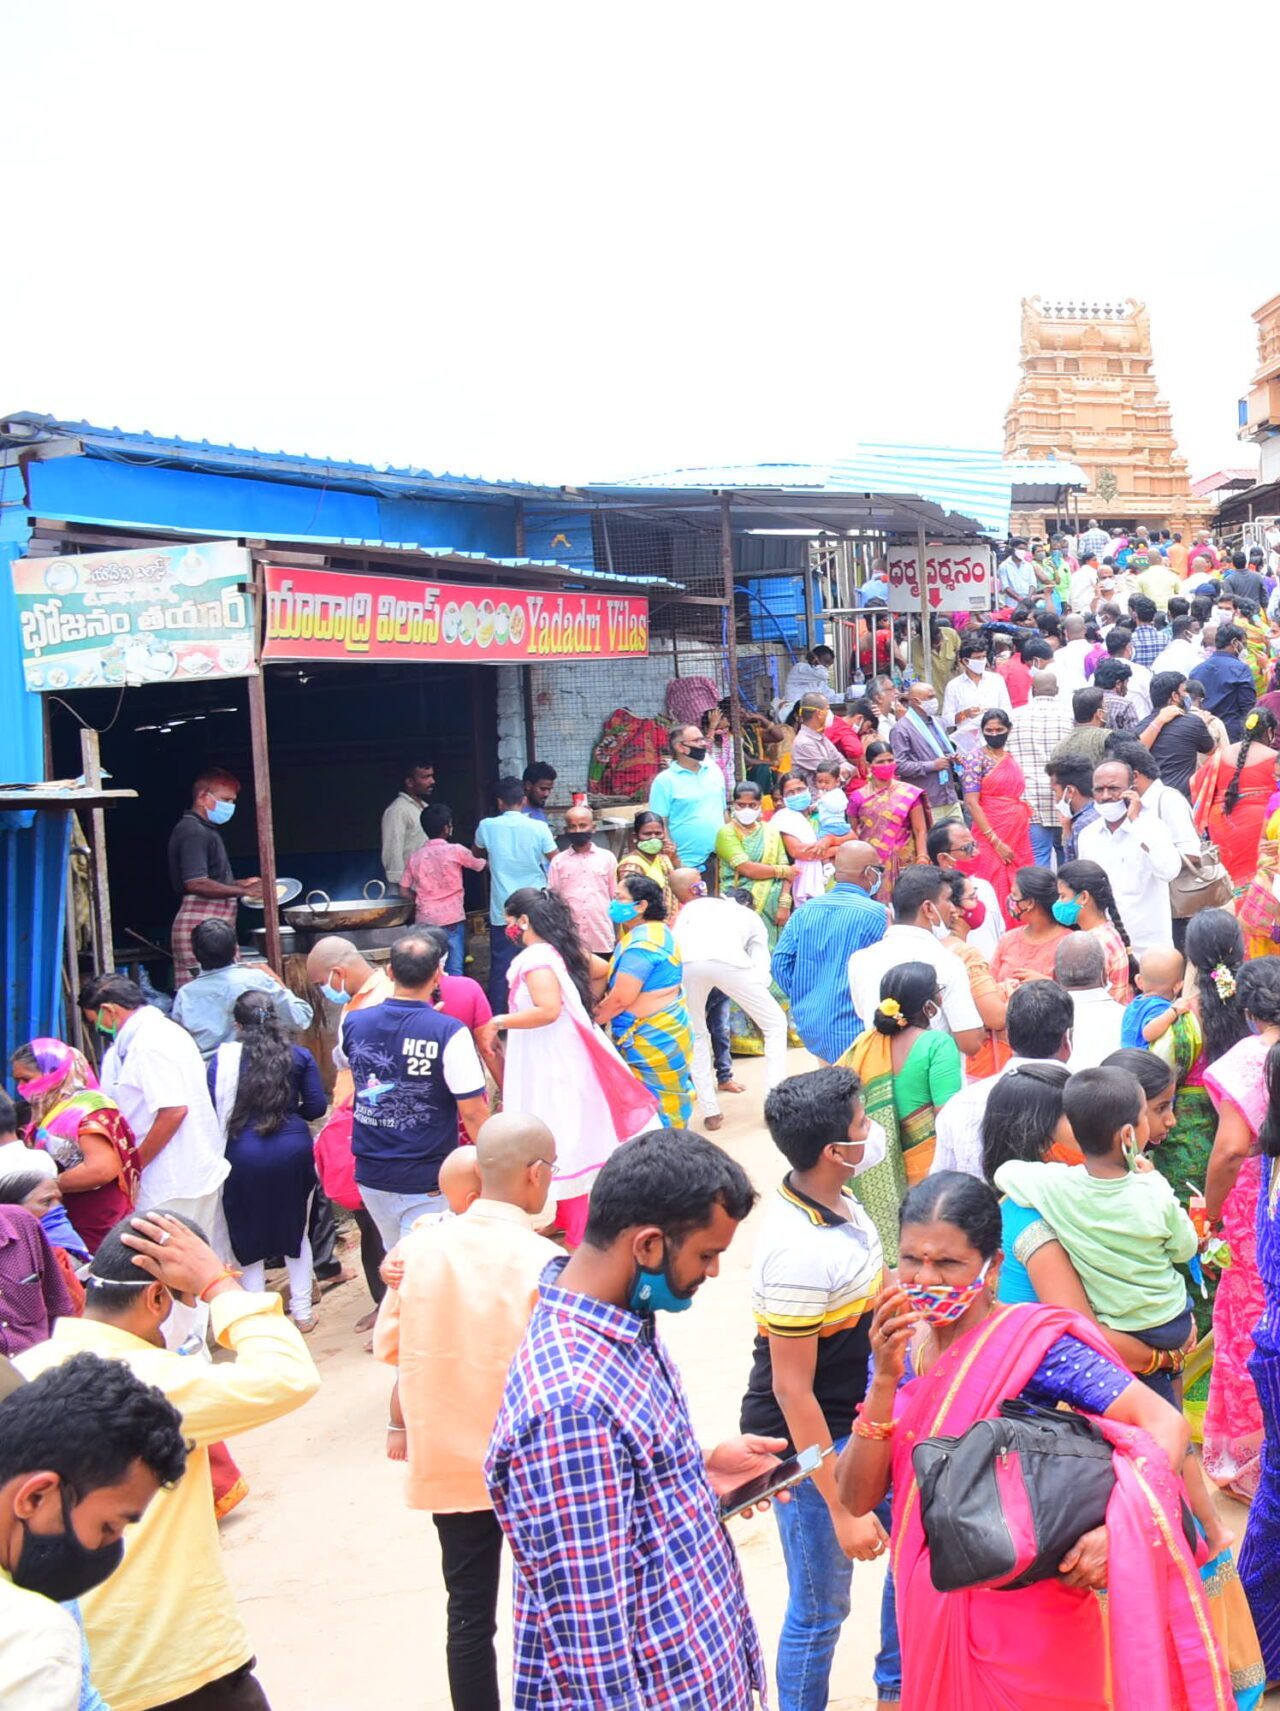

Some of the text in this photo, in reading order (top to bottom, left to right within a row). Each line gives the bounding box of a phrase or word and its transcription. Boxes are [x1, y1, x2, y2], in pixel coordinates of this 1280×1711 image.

[889, 556, 985, 598] ధర్మ దర్శనం
[20, 597, 131, 658] భోజనం
[137, 584, 247, 630] తయార్
[267, 579, 441, 652] యాదాద్రి విలాస్
[526, 596, 647, 655] Yadadri Vilas
[402, 1037, 439, 1060] HCO
[406, 1056, 432, 1076] 22
